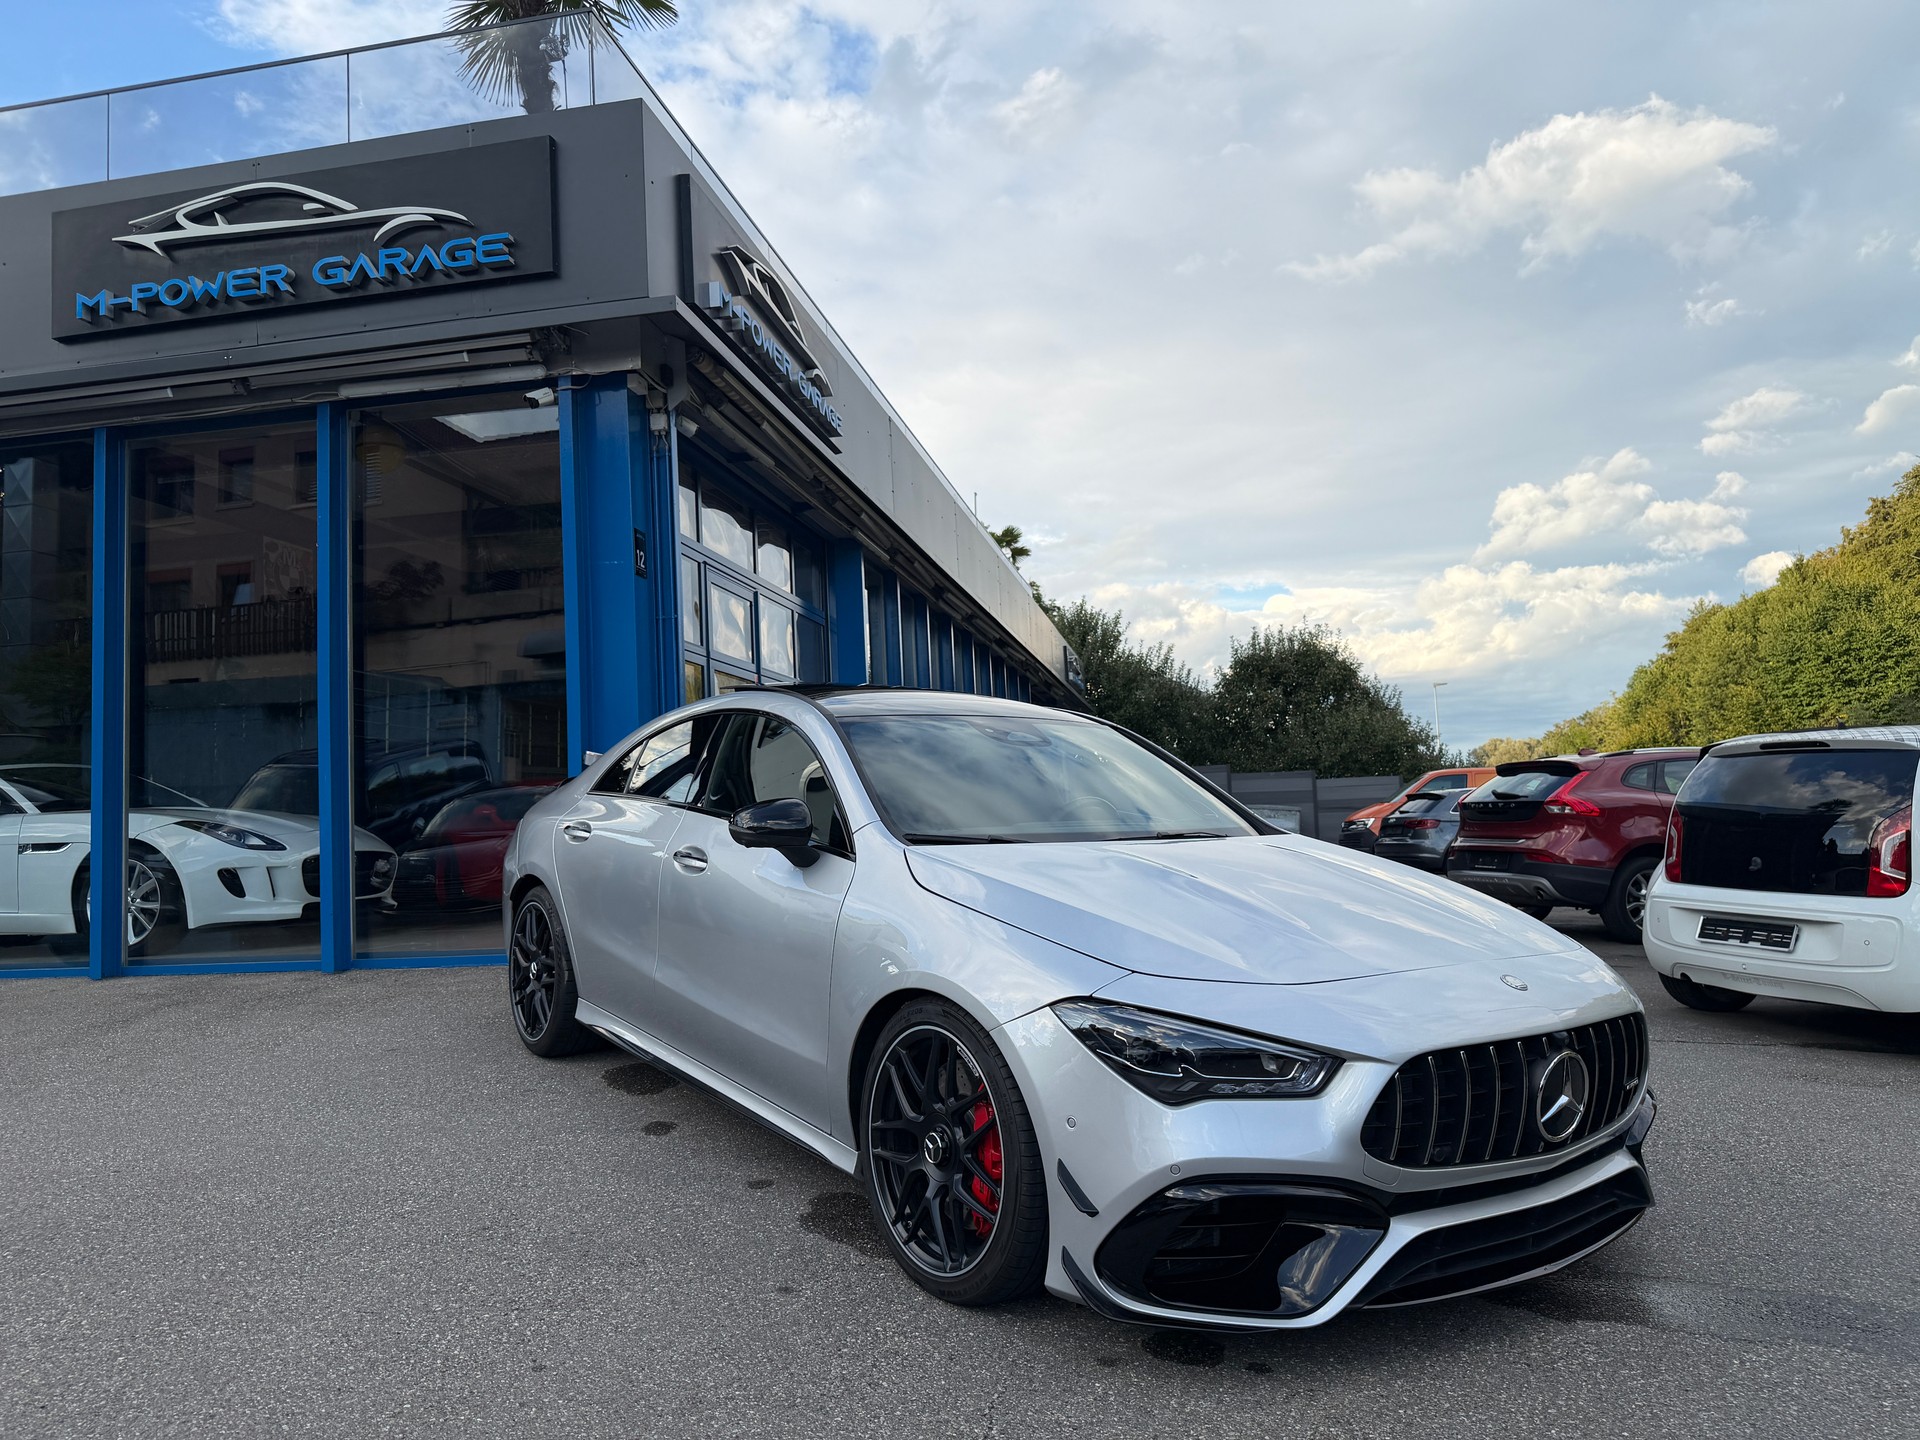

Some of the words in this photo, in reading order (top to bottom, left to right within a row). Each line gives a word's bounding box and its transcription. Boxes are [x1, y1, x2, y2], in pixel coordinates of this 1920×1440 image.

[76, 263, 290, 319] M-POWER
[312, 232, 513, 286] GARAGE
[709, 281, 793, 381] M-POWER
[798, 371, 843, 431] GARAGE
[636, 549, 645, 568] 12
